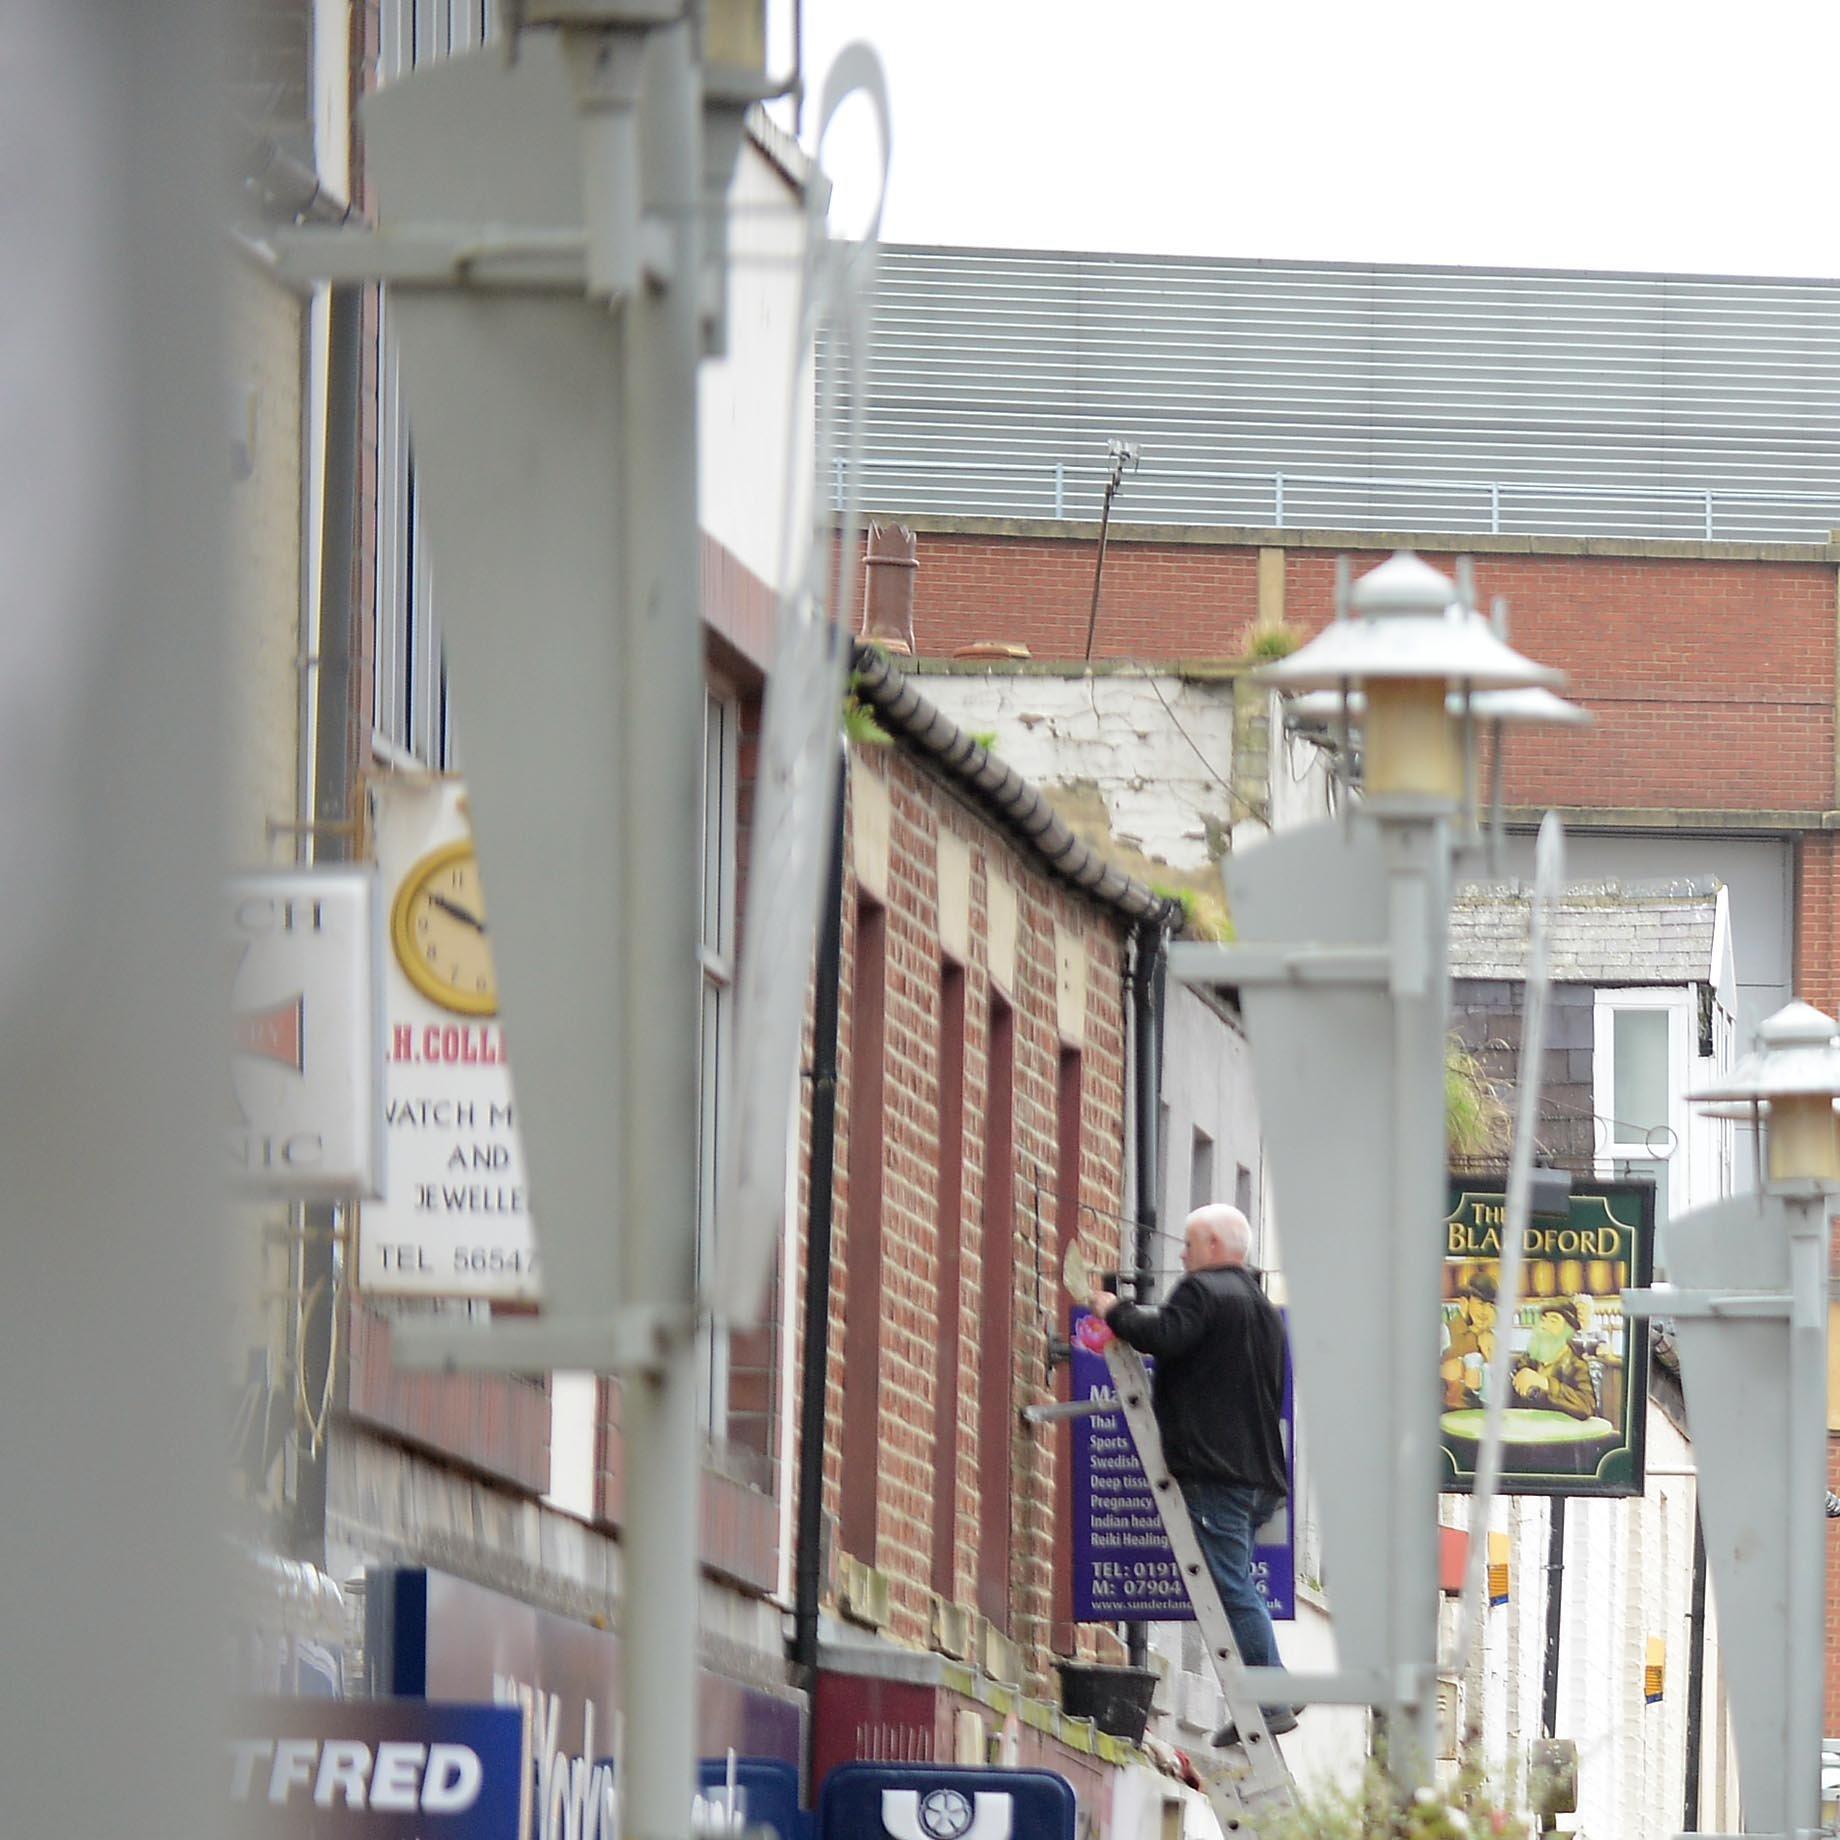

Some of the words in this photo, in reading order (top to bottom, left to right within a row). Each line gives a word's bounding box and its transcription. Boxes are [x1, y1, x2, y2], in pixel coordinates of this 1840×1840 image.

[448, 1145, 509, 1171] AND
[1449, 1223, 1621, 1256] BLADFORD
[376, 1245, 433, 1274] TEL
[1090, 1415, 1117, 1430] Thai
[1090, 1435, 1129, 1452] Sports
[1090, 1455, 1140, 1468] Swedish
[1091, 1476, 1120, 1493] Deep
[1091, 1495, 1153, 1513] Pregnancy
[1091, 1515, 1129, 1528] Indian
[1132, 1515, 1160, 1528] head
[1091, 1534, 1120, 1547] Reiki
[1123, 1534, 1169, 1550] Healing
[1092, 1561, 1130, 1577] TEL:
[1092, 1580, 1116, 1595] M:
